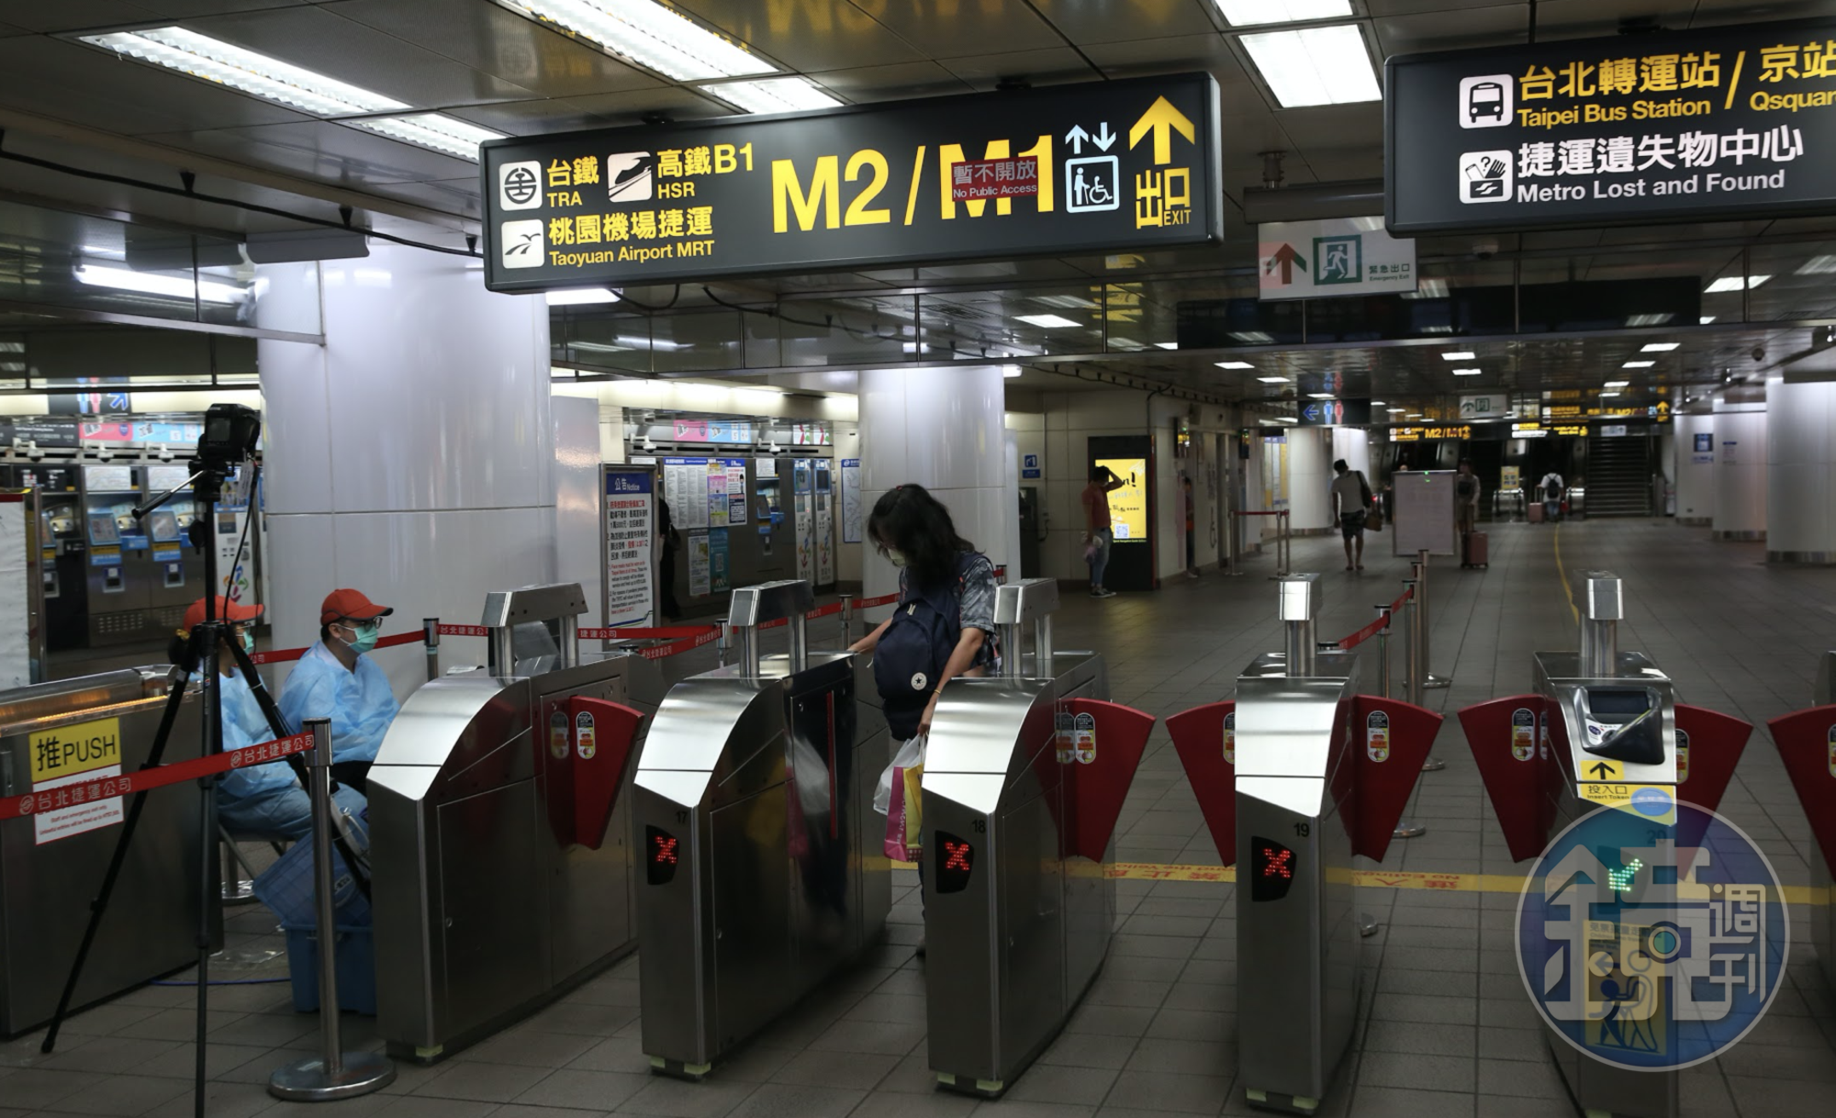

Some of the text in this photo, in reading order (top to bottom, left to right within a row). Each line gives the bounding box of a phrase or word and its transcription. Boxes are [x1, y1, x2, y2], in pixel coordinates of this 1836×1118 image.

[1519, 51, 1721, 101] 台北轉運站
[1759, 40, 1836, 83] 京站
[1517, 108, 1579, 130] Taipei
[1584, 106, 1627, 122] Bus
[1632, 98, 1711, 120] Station
[1518, 124, 1803, 178] 捷運遺失物中心
[547, 156, 599, 187] 台鐵
[953, 160, 1037, 185] 暫不開放
[547, 191, 582, 207] TRA
[658, 182, 695, 199] HSR
[953, 183, 1037, 199] No Public Access
[1135, 167, 1190, 229] 出口
[1518, 169, 1785, 203] Metro Lost and Found
[549, 206, 713, 246] 桃園機場捷運
[1164, 209, 1191, 225] EXIT
[549, 240, 714, 267] Taoyuan Airport MRT
[440, 625, 489, 636] 台北捷運公
[244, 734, 314, 764] 台北捷運公司
[38, 778, 131, 811] 台北捷運公司
[1588, 784, 1627, 794] 投入口
[972, 820, 986, 834] 18
[1294, 823, 1309, 837] 19
